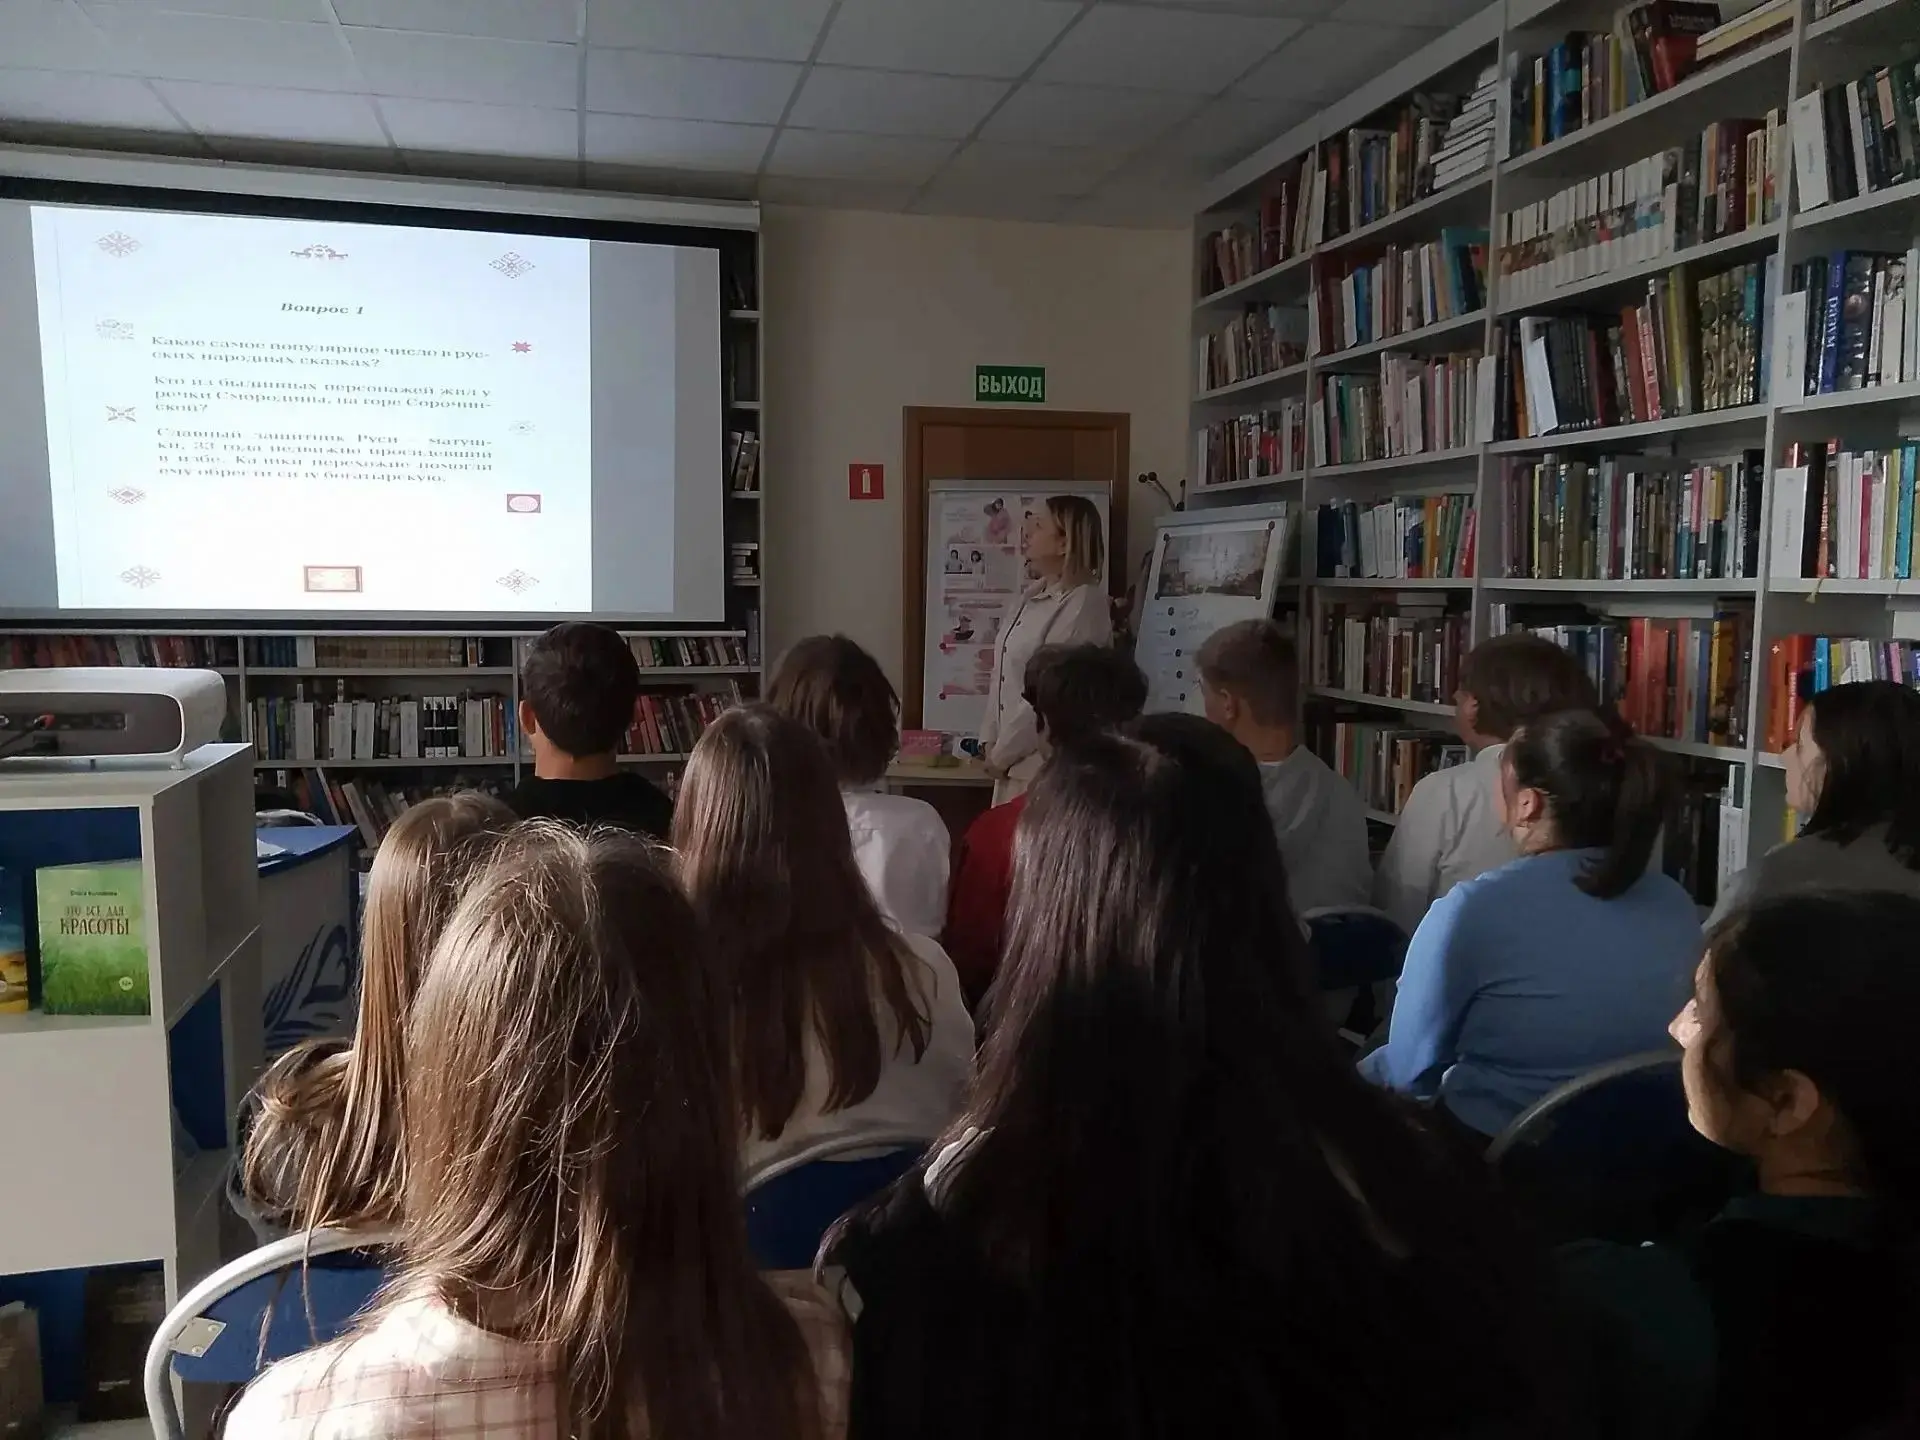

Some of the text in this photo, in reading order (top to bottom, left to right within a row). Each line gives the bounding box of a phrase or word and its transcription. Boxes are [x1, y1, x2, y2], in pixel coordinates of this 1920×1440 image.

[281, 303, 364, 315] Вопрос 1
[152, 336, 206, 348] Какое
[210, 340, 265, 350] самое
[270, 342, 380, 354] популярное
[384, 348, 437, 357] число
[455, 350, 491, 360] рус-
[152, 351, 380, 367] ских народных сказках?
[155, 375, 185, 386] Кто
[218, 379, 317, 391] былинных
[325, 383, 434, 395] персонажей
[440, 389, 476, 397] жил
[482, 390, 491, 398] у
[978, 374, 1042, 398] ВЫХОД
[155, 390, 212, 401] речки
[216, 391, 332, 404] Смородины,
[337, 397, 358, 405] на
[363, 398, 401, 408] горе
[155, 403, 208, 412] ской?
[157, 427, 242, 439] Славный
[357, 433, 399, 443] Руси
[60, 917, 130, 936] КРАСОТЫ
